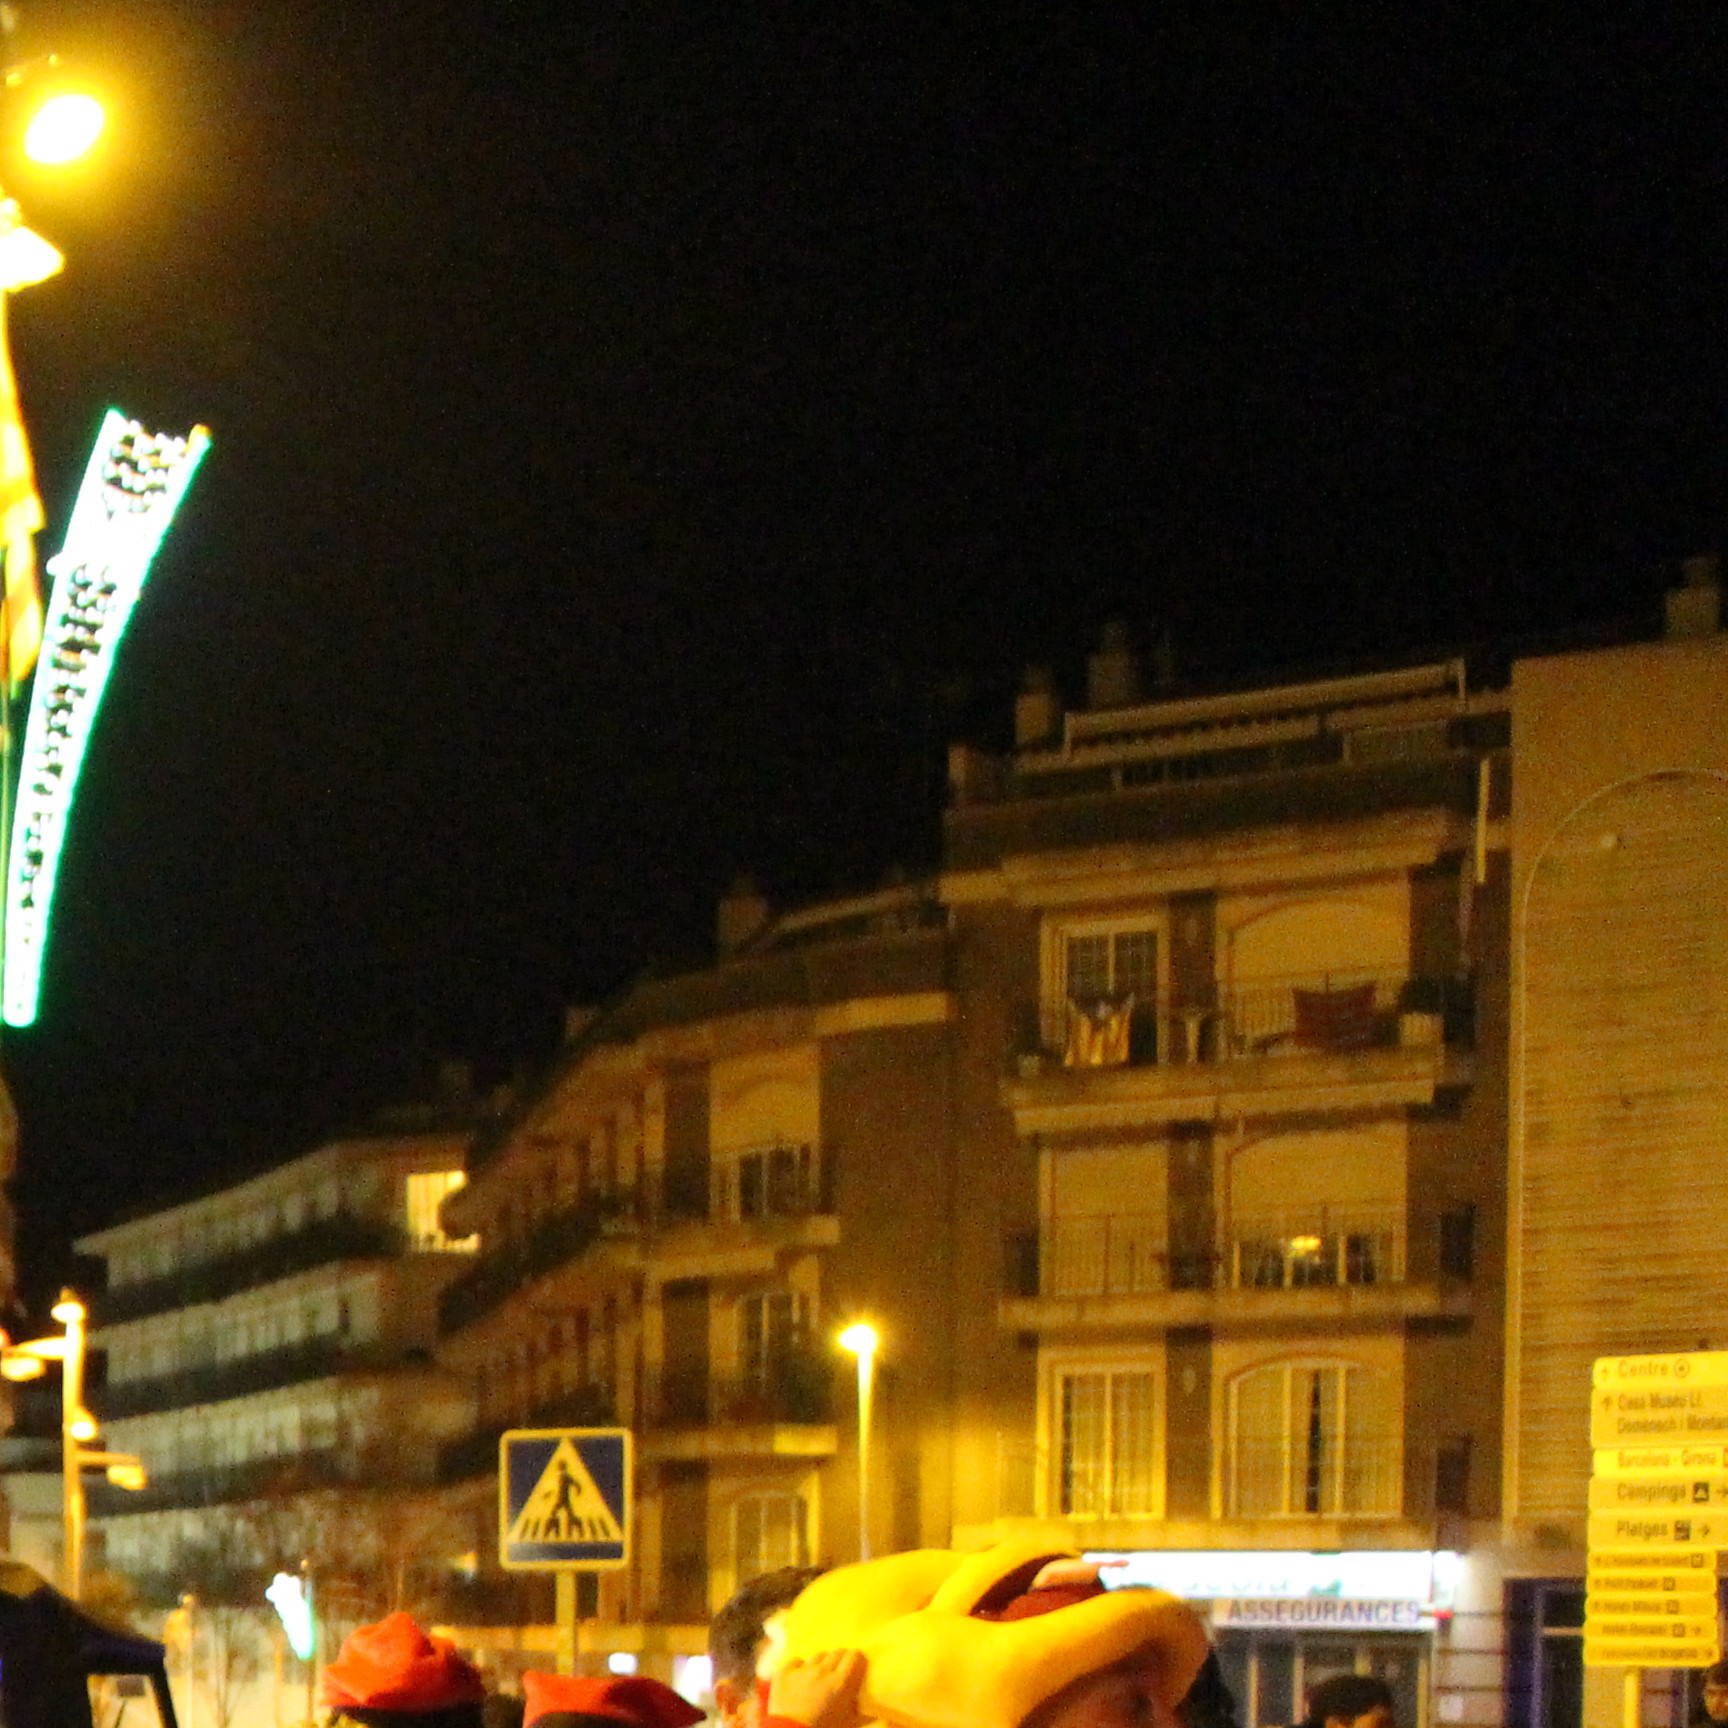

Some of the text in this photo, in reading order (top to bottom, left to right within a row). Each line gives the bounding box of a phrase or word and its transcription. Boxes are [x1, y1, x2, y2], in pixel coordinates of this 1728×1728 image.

[1618, 1359, 1668, 1377] Centre
[1616, 1520, 1669, 1542] Platges
[1228, 1599, 1420, 1624] ASSEGURANCES
